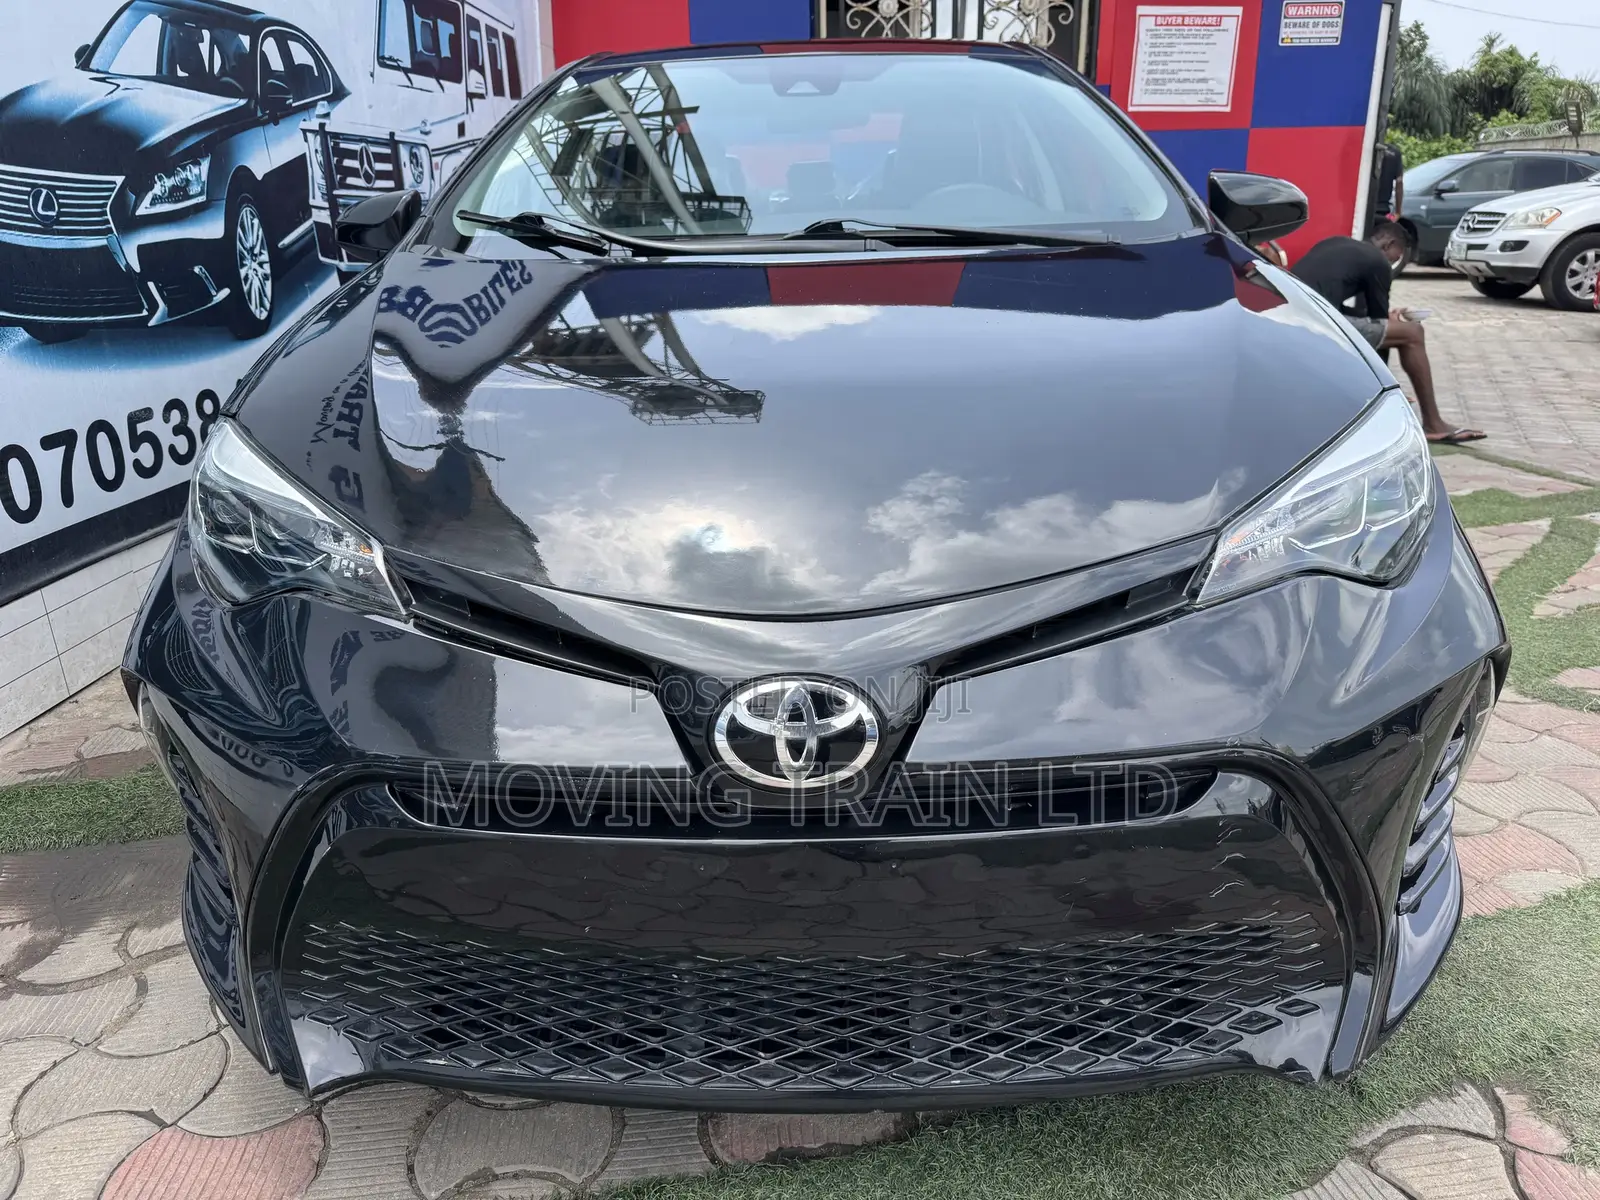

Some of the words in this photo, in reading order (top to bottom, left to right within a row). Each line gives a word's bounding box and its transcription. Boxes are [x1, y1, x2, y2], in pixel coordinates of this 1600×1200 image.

[1288, 6, 1339, 16] WARNING
[1156, 16, 1182, 25] BUYER
[1184, 16, 1221, 25] BEWARE!
[1284, 21, 1310, 29] BEWARE
[1311, 21, 1321, 29] OF
[1321, 21, 1340, 29] DOGS
